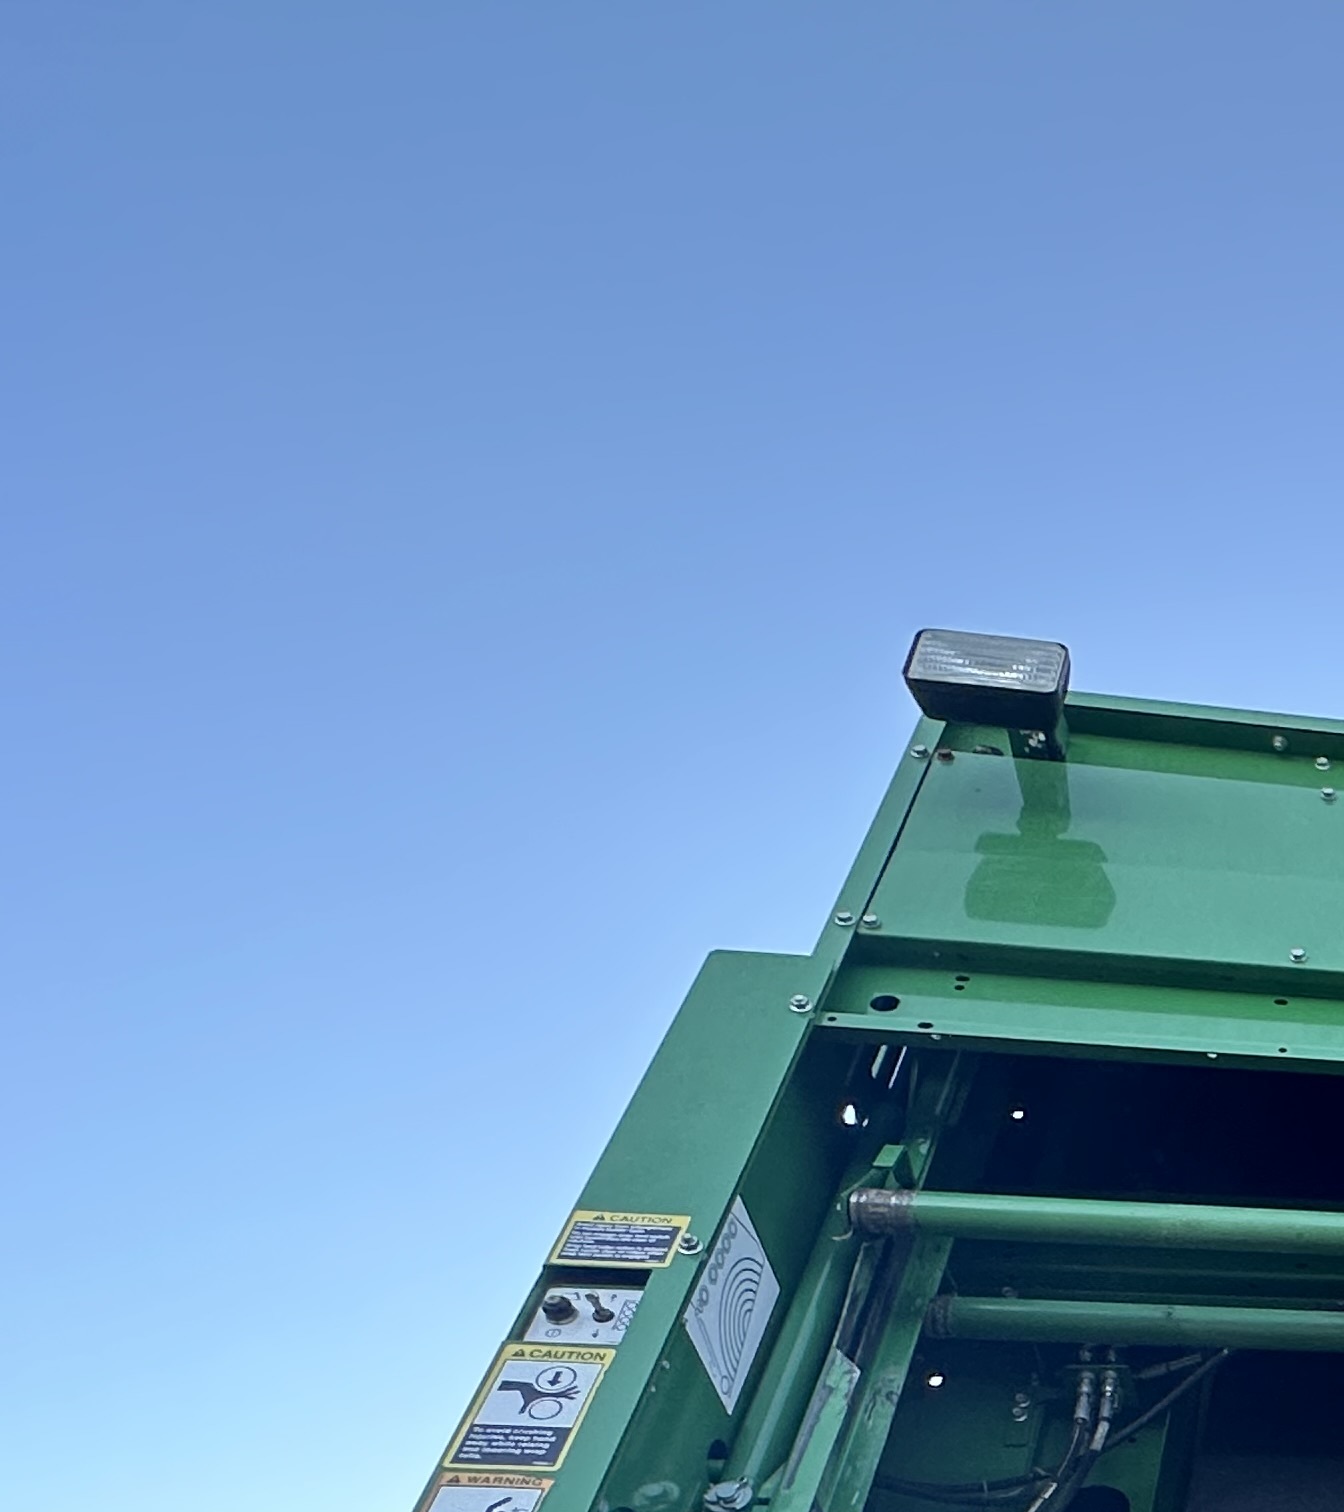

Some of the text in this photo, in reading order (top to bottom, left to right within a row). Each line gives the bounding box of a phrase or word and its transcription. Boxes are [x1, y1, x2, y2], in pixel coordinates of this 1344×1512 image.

[610, 1214, 673, 1224] CAUTION
[529, 1349, 607, 1361] CAUTION
[467, 1476, 543, 1486] WARNING
